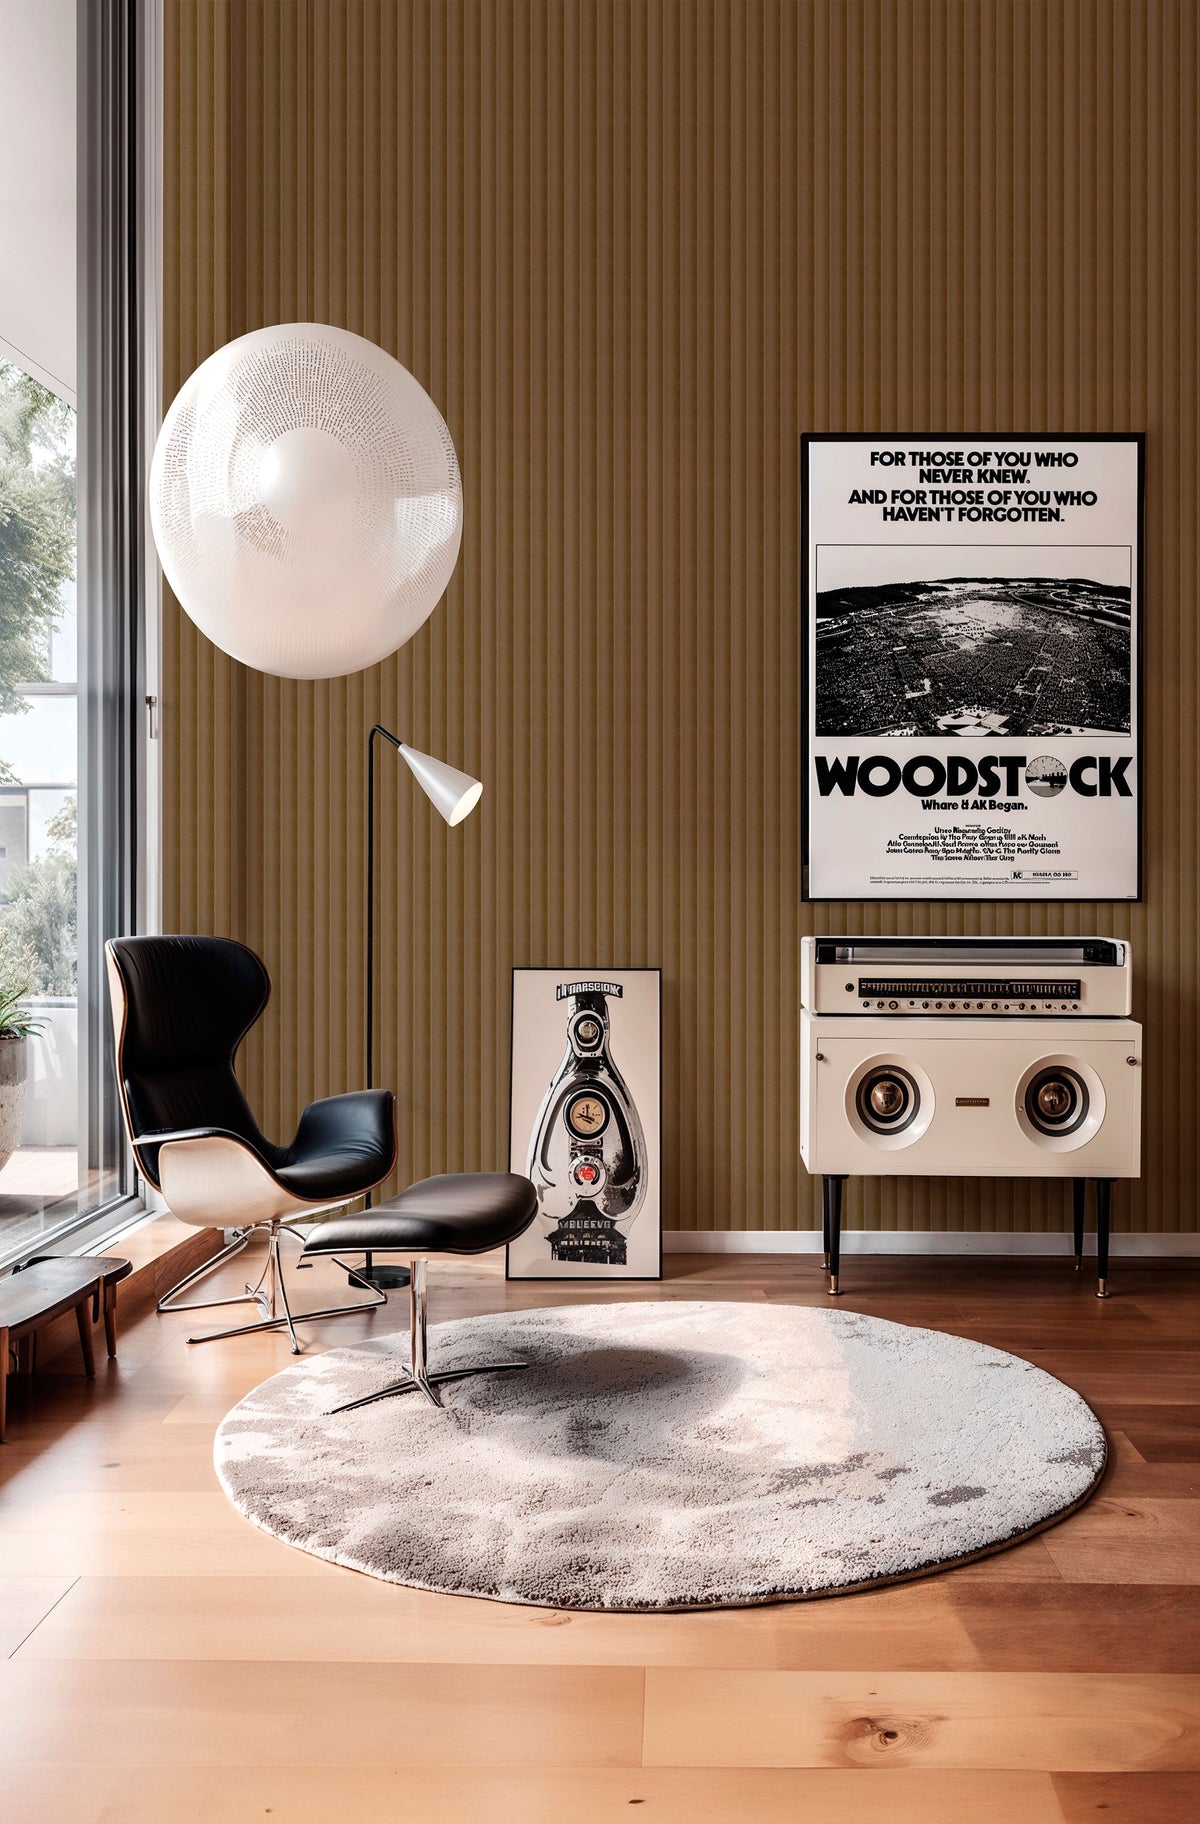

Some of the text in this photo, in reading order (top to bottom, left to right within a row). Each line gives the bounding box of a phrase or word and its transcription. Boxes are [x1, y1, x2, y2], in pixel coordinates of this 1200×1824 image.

[870, 451, 1079, 468] FOR THOSE OF YOU WHO
[918, 468, 1031, 484] NEVER KNEW.
[847, 489, 1098, 507] AND FOR THOSE OF YOU WHO
[882, 506, 1066, 523] HAVEN'T FORGOTTEN.
[988, 799, 1029, 813] Began.
